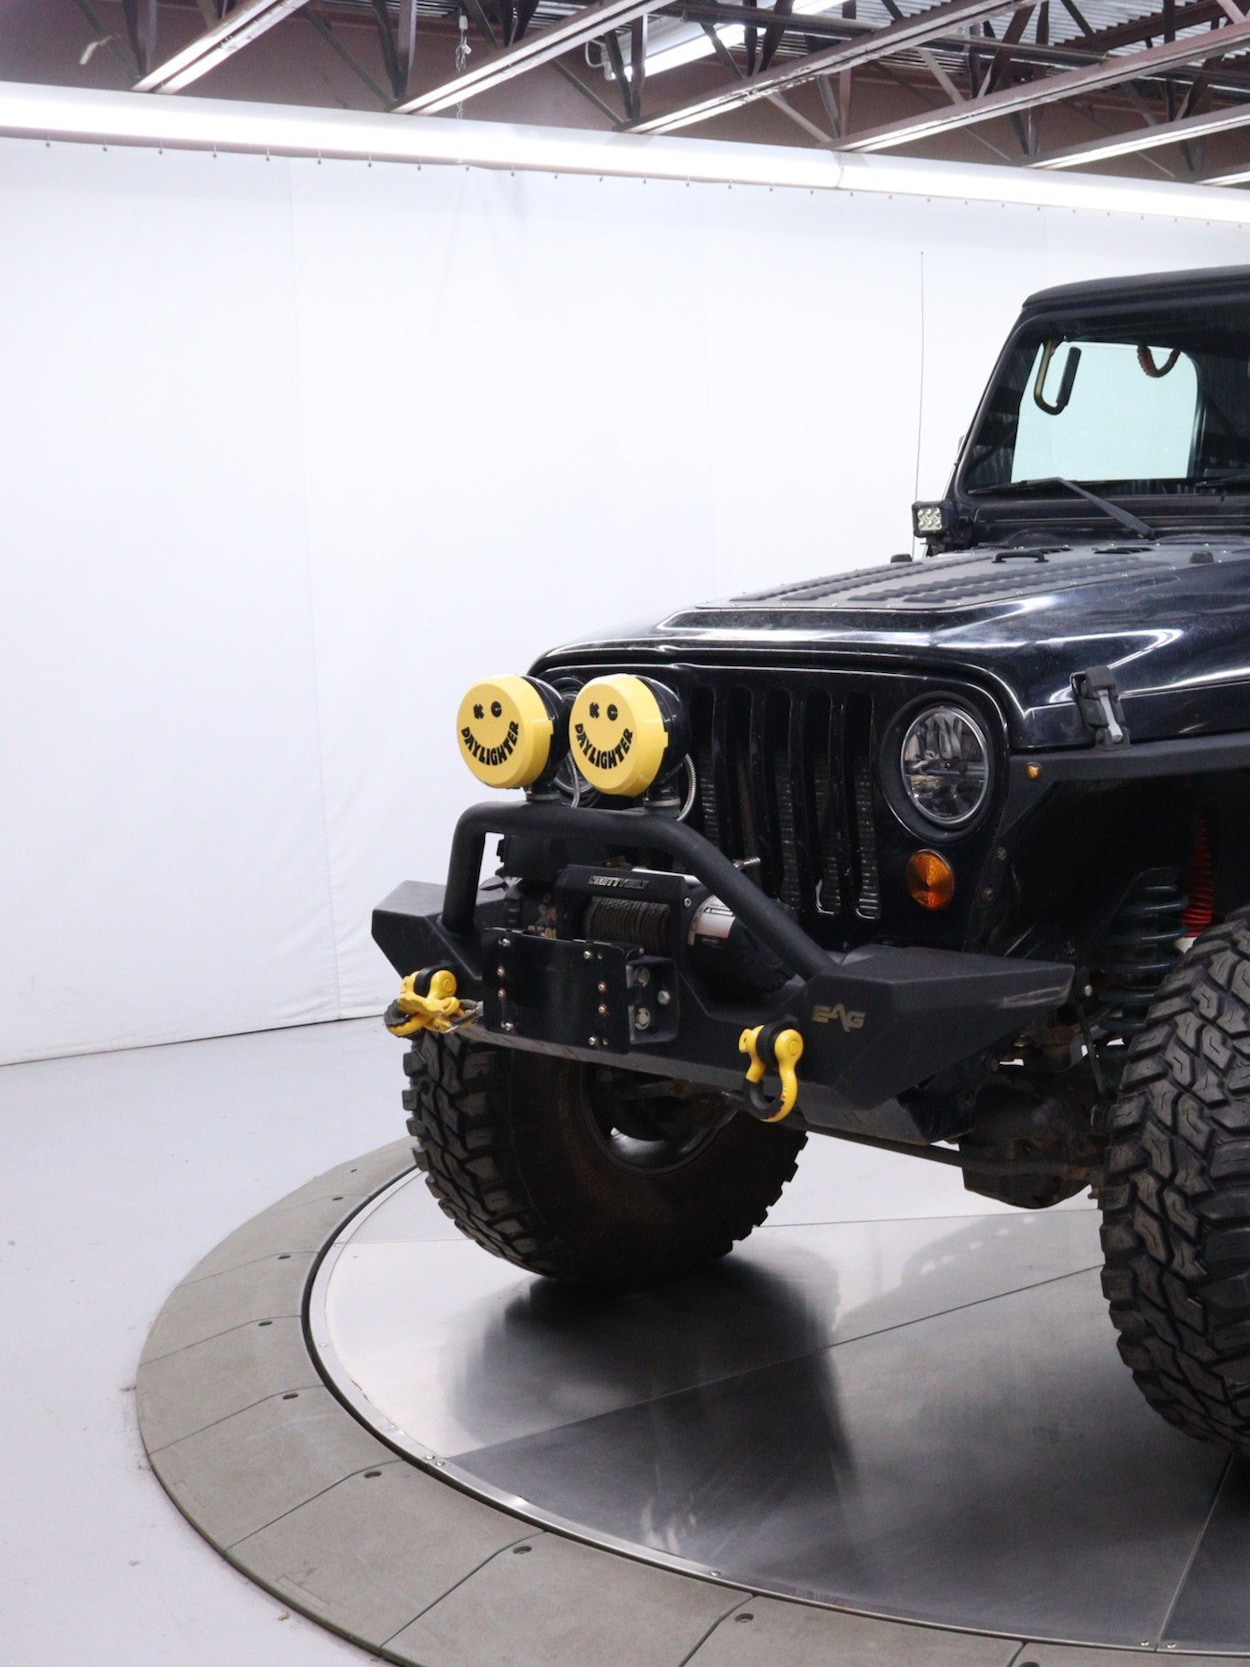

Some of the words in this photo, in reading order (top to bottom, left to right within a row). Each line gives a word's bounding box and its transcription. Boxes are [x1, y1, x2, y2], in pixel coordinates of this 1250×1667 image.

[461, 720, 519, 766] DAYLIGHTER
[575, 722, 633, 769] DAYLIGHTER
[812, 1003, 866, 1032] EAG
